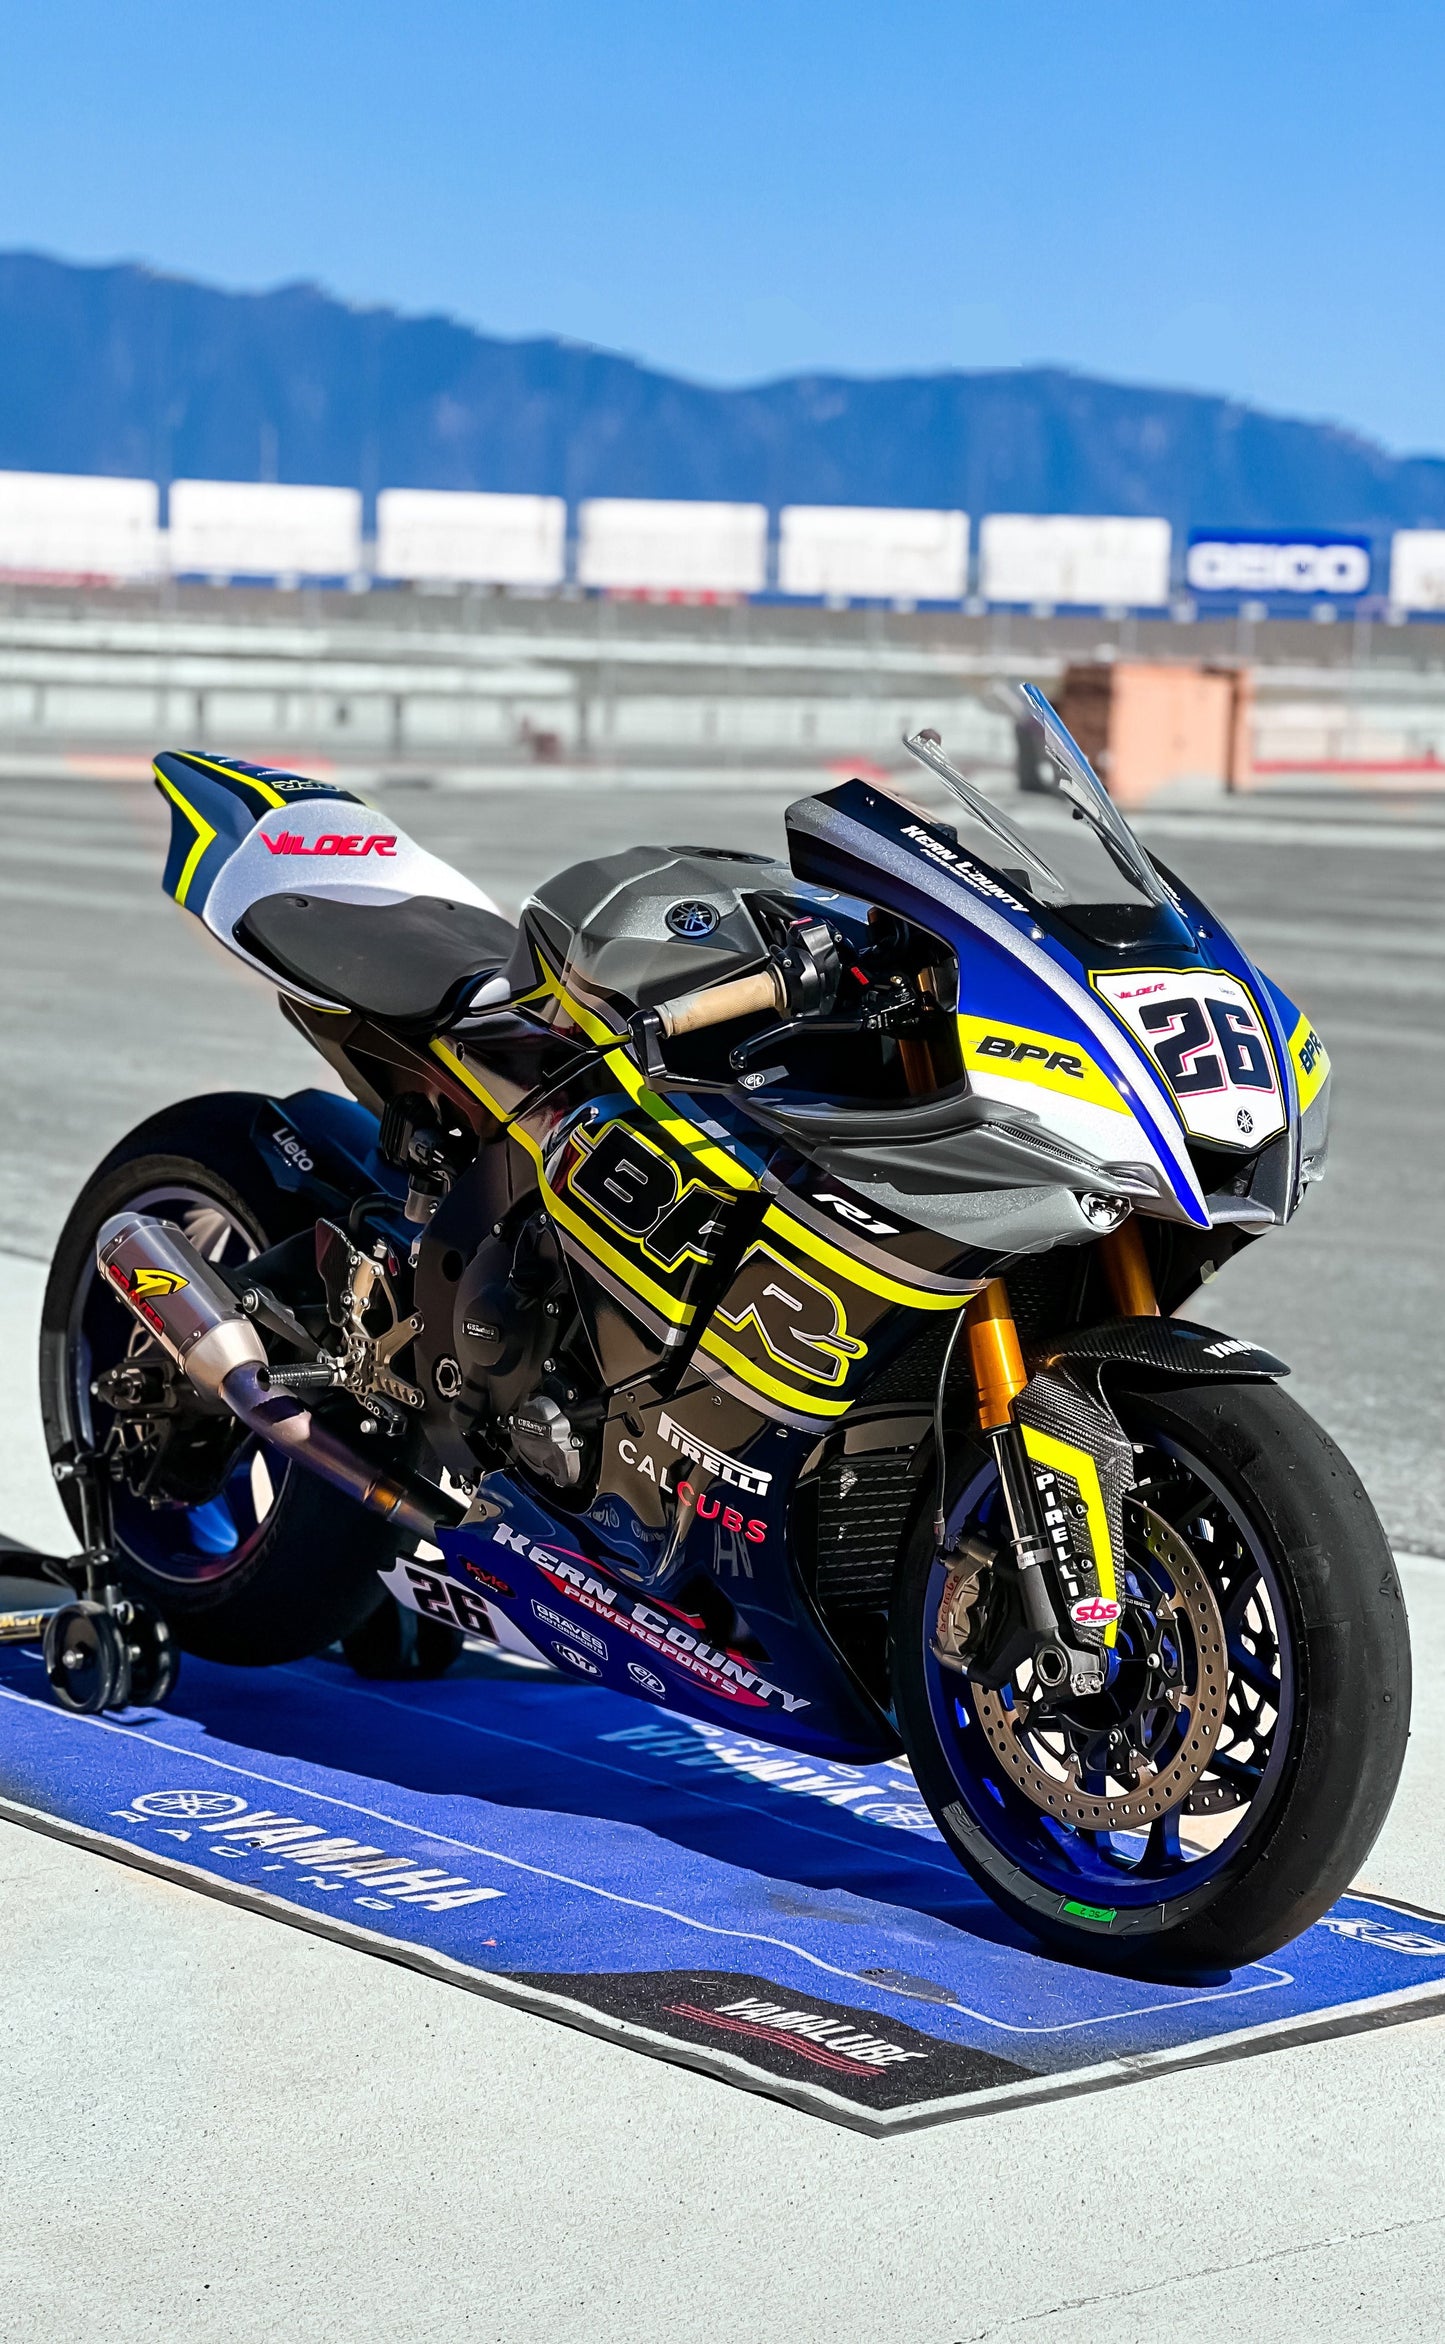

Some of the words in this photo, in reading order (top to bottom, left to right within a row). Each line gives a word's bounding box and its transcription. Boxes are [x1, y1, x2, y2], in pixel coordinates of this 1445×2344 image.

[259, 831, 397, 857] VILDER
[900, 825, 958, 861] KERN
[974, 1033, 1086, 1079] BPR
[1139, 997, 1275, 1098] 26
[1299, 1031, 1323, 1076] BPR
[813, 1193, 900, 1235] R1
[657, 1411, 773, 1497] PIRELLI
[618, 1439, 768, 1544] CALCUBS
[1036, 1473, 1080, 1597] PIRELLI
[404, 1565, 500, 1643] 26
[492, 1523, 617, 1605] KERN
[630, 1602, 812, 1714] COUNTY
[537, 1604, 604, 1650] GRAVES
[538, 1612, 604, 1656] MOTORSPORTS
[564, 1584, 738, 1696] POWERSPORTS
[1075, 1597, 1118, 1622] sbs
[107, 1810, 396, 1911] RACING
[200, 1811, 507, 1912] YAMAHA
[714, 1998, 929, 2067] YAMALUBE
